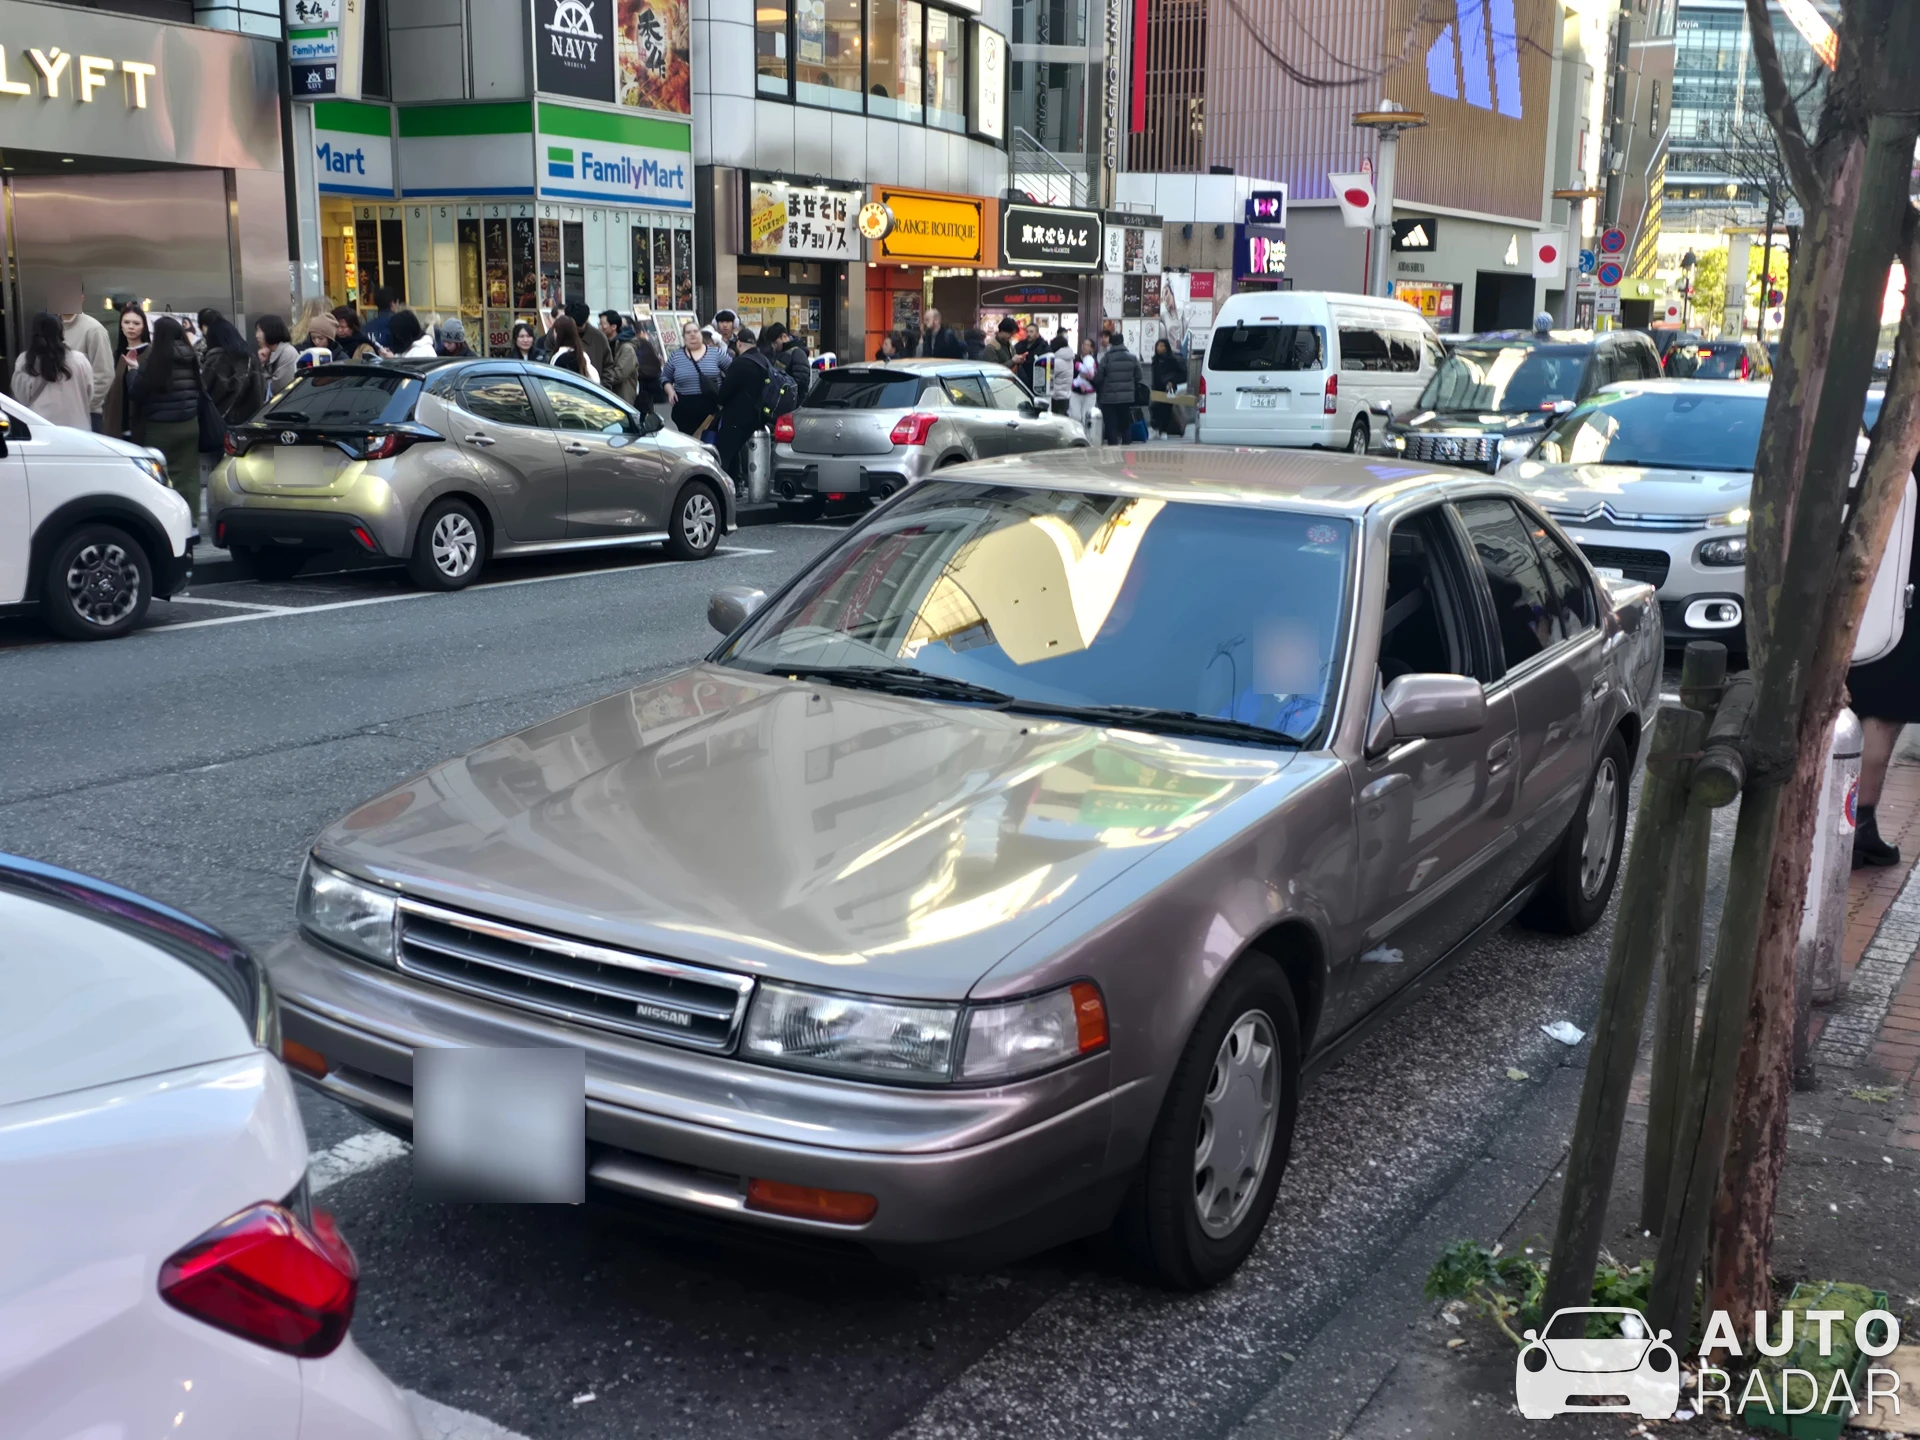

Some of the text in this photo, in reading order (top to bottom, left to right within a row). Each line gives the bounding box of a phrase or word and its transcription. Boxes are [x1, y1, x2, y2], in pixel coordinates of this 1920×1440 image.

[292, 44, 336, 56] FamilyMart
[551, 34, 598, 62] NAVY
[1108, 56, 1119, 119] LOUIS
[1107, 127, 1117, 169] BLD
[316, 142, 365, 175] Mart
[581, 151, 684, 190] FamilyMart
[363, 207, 370, 219] 8
[388, 207, 395, 219] 7
[414, 207, 421, 218] 6
[440, 207, 447, 218] 5
[466, 206, 472, 218] 4
[492, 206, 499, 217] 3
[519, 204, 526, 216] 2
[545, 206, 550, 217] 8
[788, 192, 847, 222] まぜそば
[1254, 198, 1279, 217] BR
[569, 208, 575, 219] 7
[592, 211, 598, 222] 6
[615, 213, 620, 224] 5
[752, 210, 773, 228] ニンニク
[637, 215, 642, 225] 4
[658, 216, 664, 227] 3
[679, 217, 684, 228] 2
[800, 222, 847, 251] チョップス
[931, 221, 976, 242] BOUTIQUE
[1249, 237, 1270, 273] BR
[489, 331, 510, 345] 980
[636, 1003, 689, 1026] NISSAN
